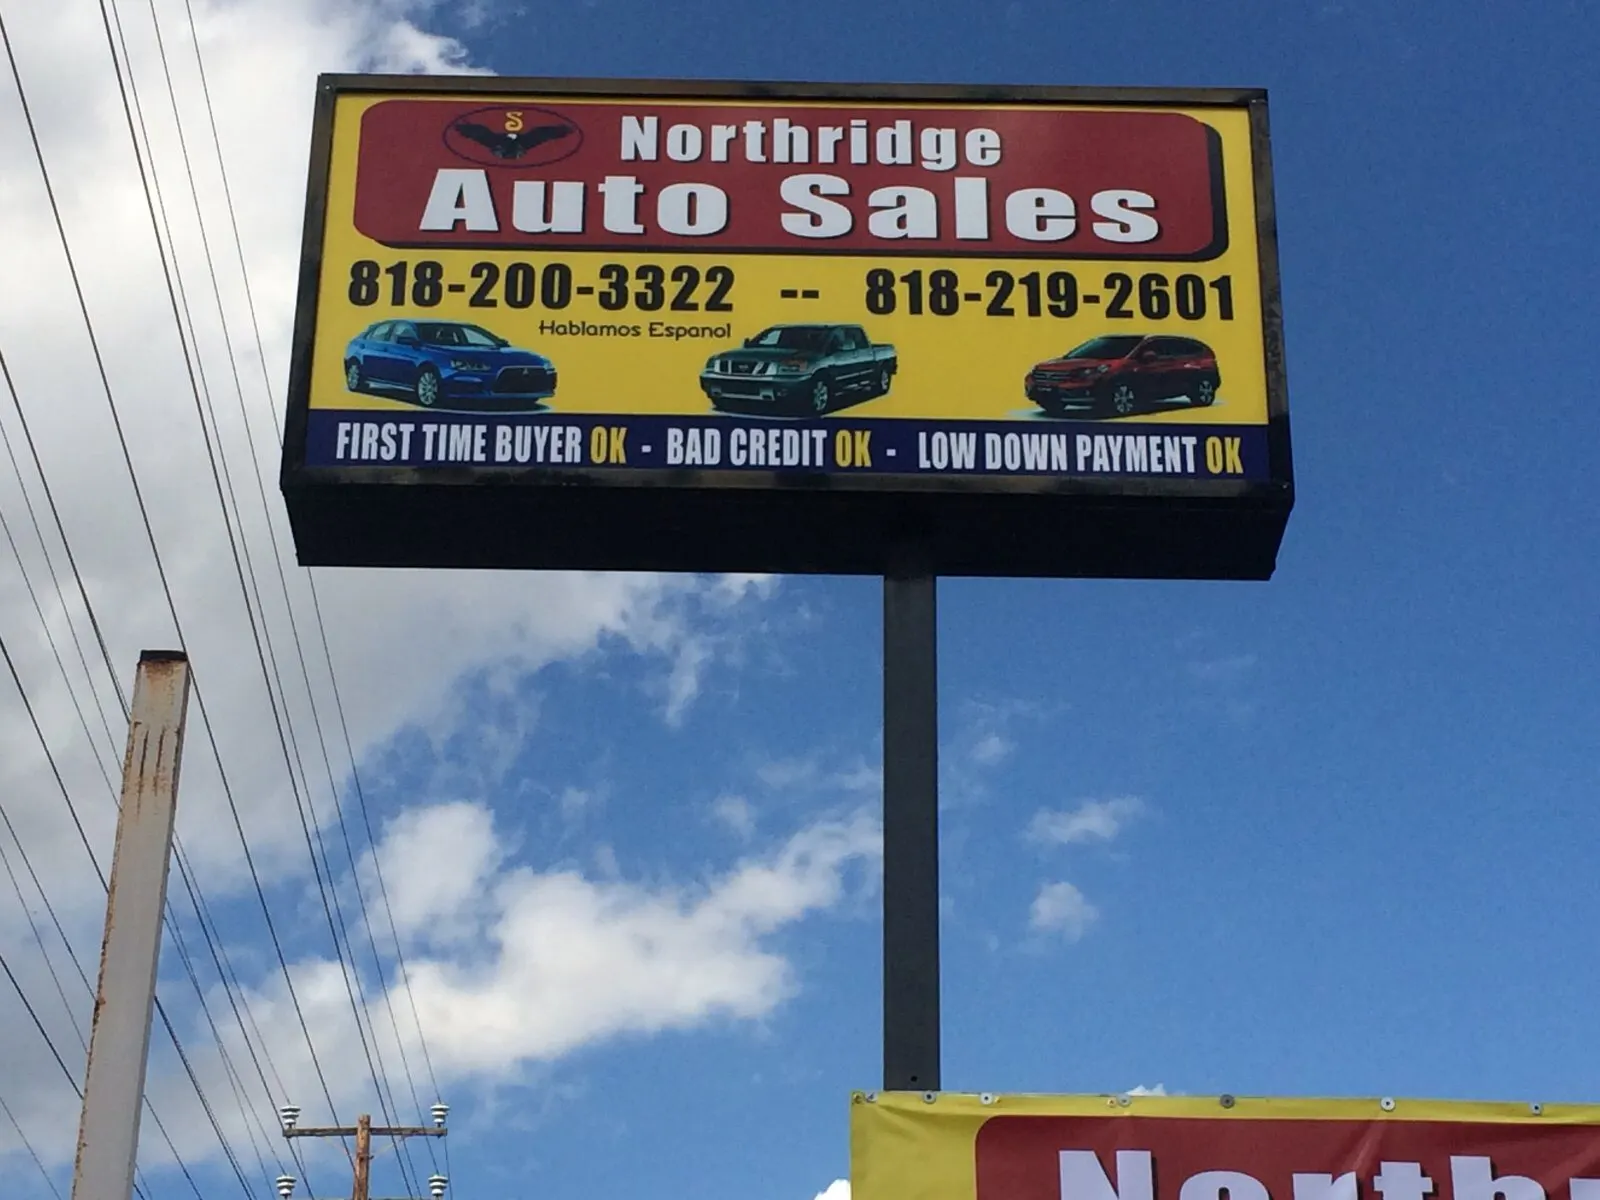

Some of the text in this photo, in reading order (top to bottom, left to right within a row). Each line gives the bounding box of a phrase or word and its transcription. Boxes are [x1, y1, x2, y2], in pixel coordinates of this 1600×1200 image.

[620, 115, 1002, 172] Northridge
[419, 168, 1160, 243] Auto Sales
[348, 260, 735, 311] 818-200-3322
[866, 268, 1234, 320] 818-219-2601
[539, 320, 731, 341] Hablamos Espanol
[336, 422, 415, 461] FIRST
[422, 424, 486, 463] TIME
[494, 425, 582, 465] BUYER
[590, 427, 627, 464] OK
[666, 428, 721, 466] BAD
[730, 430, 828, 468] CREDIT
[834, 431, 872, 469] OK
[918, 432, 976, 471] LOW
[985, 433, 1068, 472] DOWN
[1076, 435, 1197, 474] PAYMENT
[1205, 436, 1244, 475] OK
